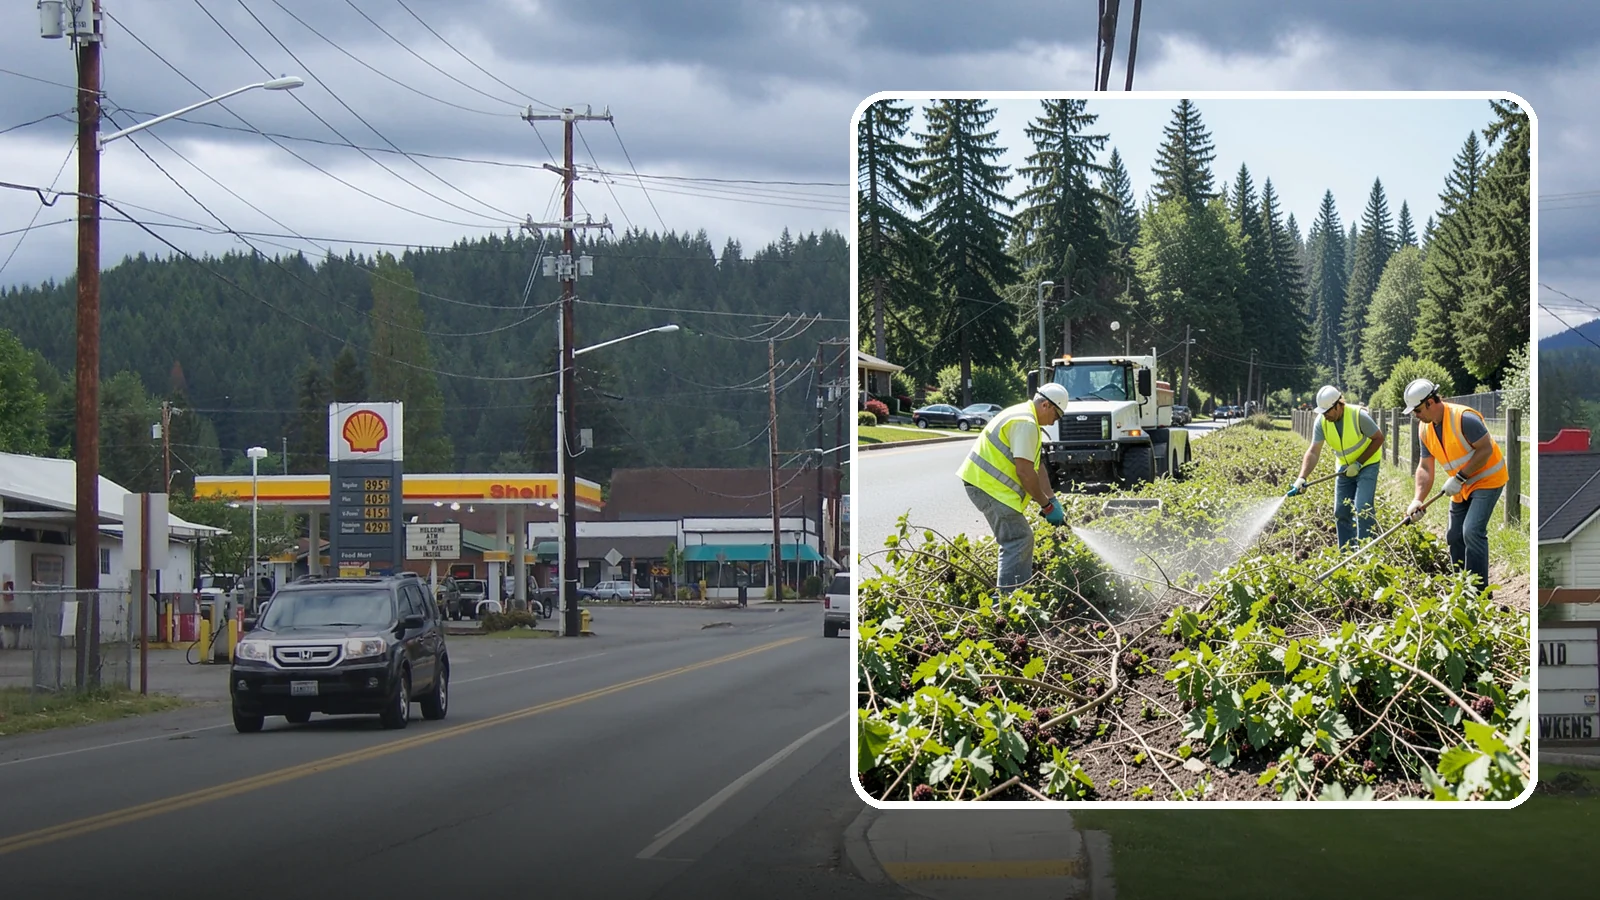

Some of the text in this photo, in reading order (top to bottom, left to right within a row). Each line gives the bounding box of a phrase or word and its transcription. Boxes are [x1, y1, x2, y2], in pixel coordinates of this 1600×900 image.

[366, 480, 384, 490] 395
[490, 484, 547, 499] Shell
[366, 494, 384, 504] 405
[366, 508, 384, 518] 415
[366, 522, 384, 532] 429
